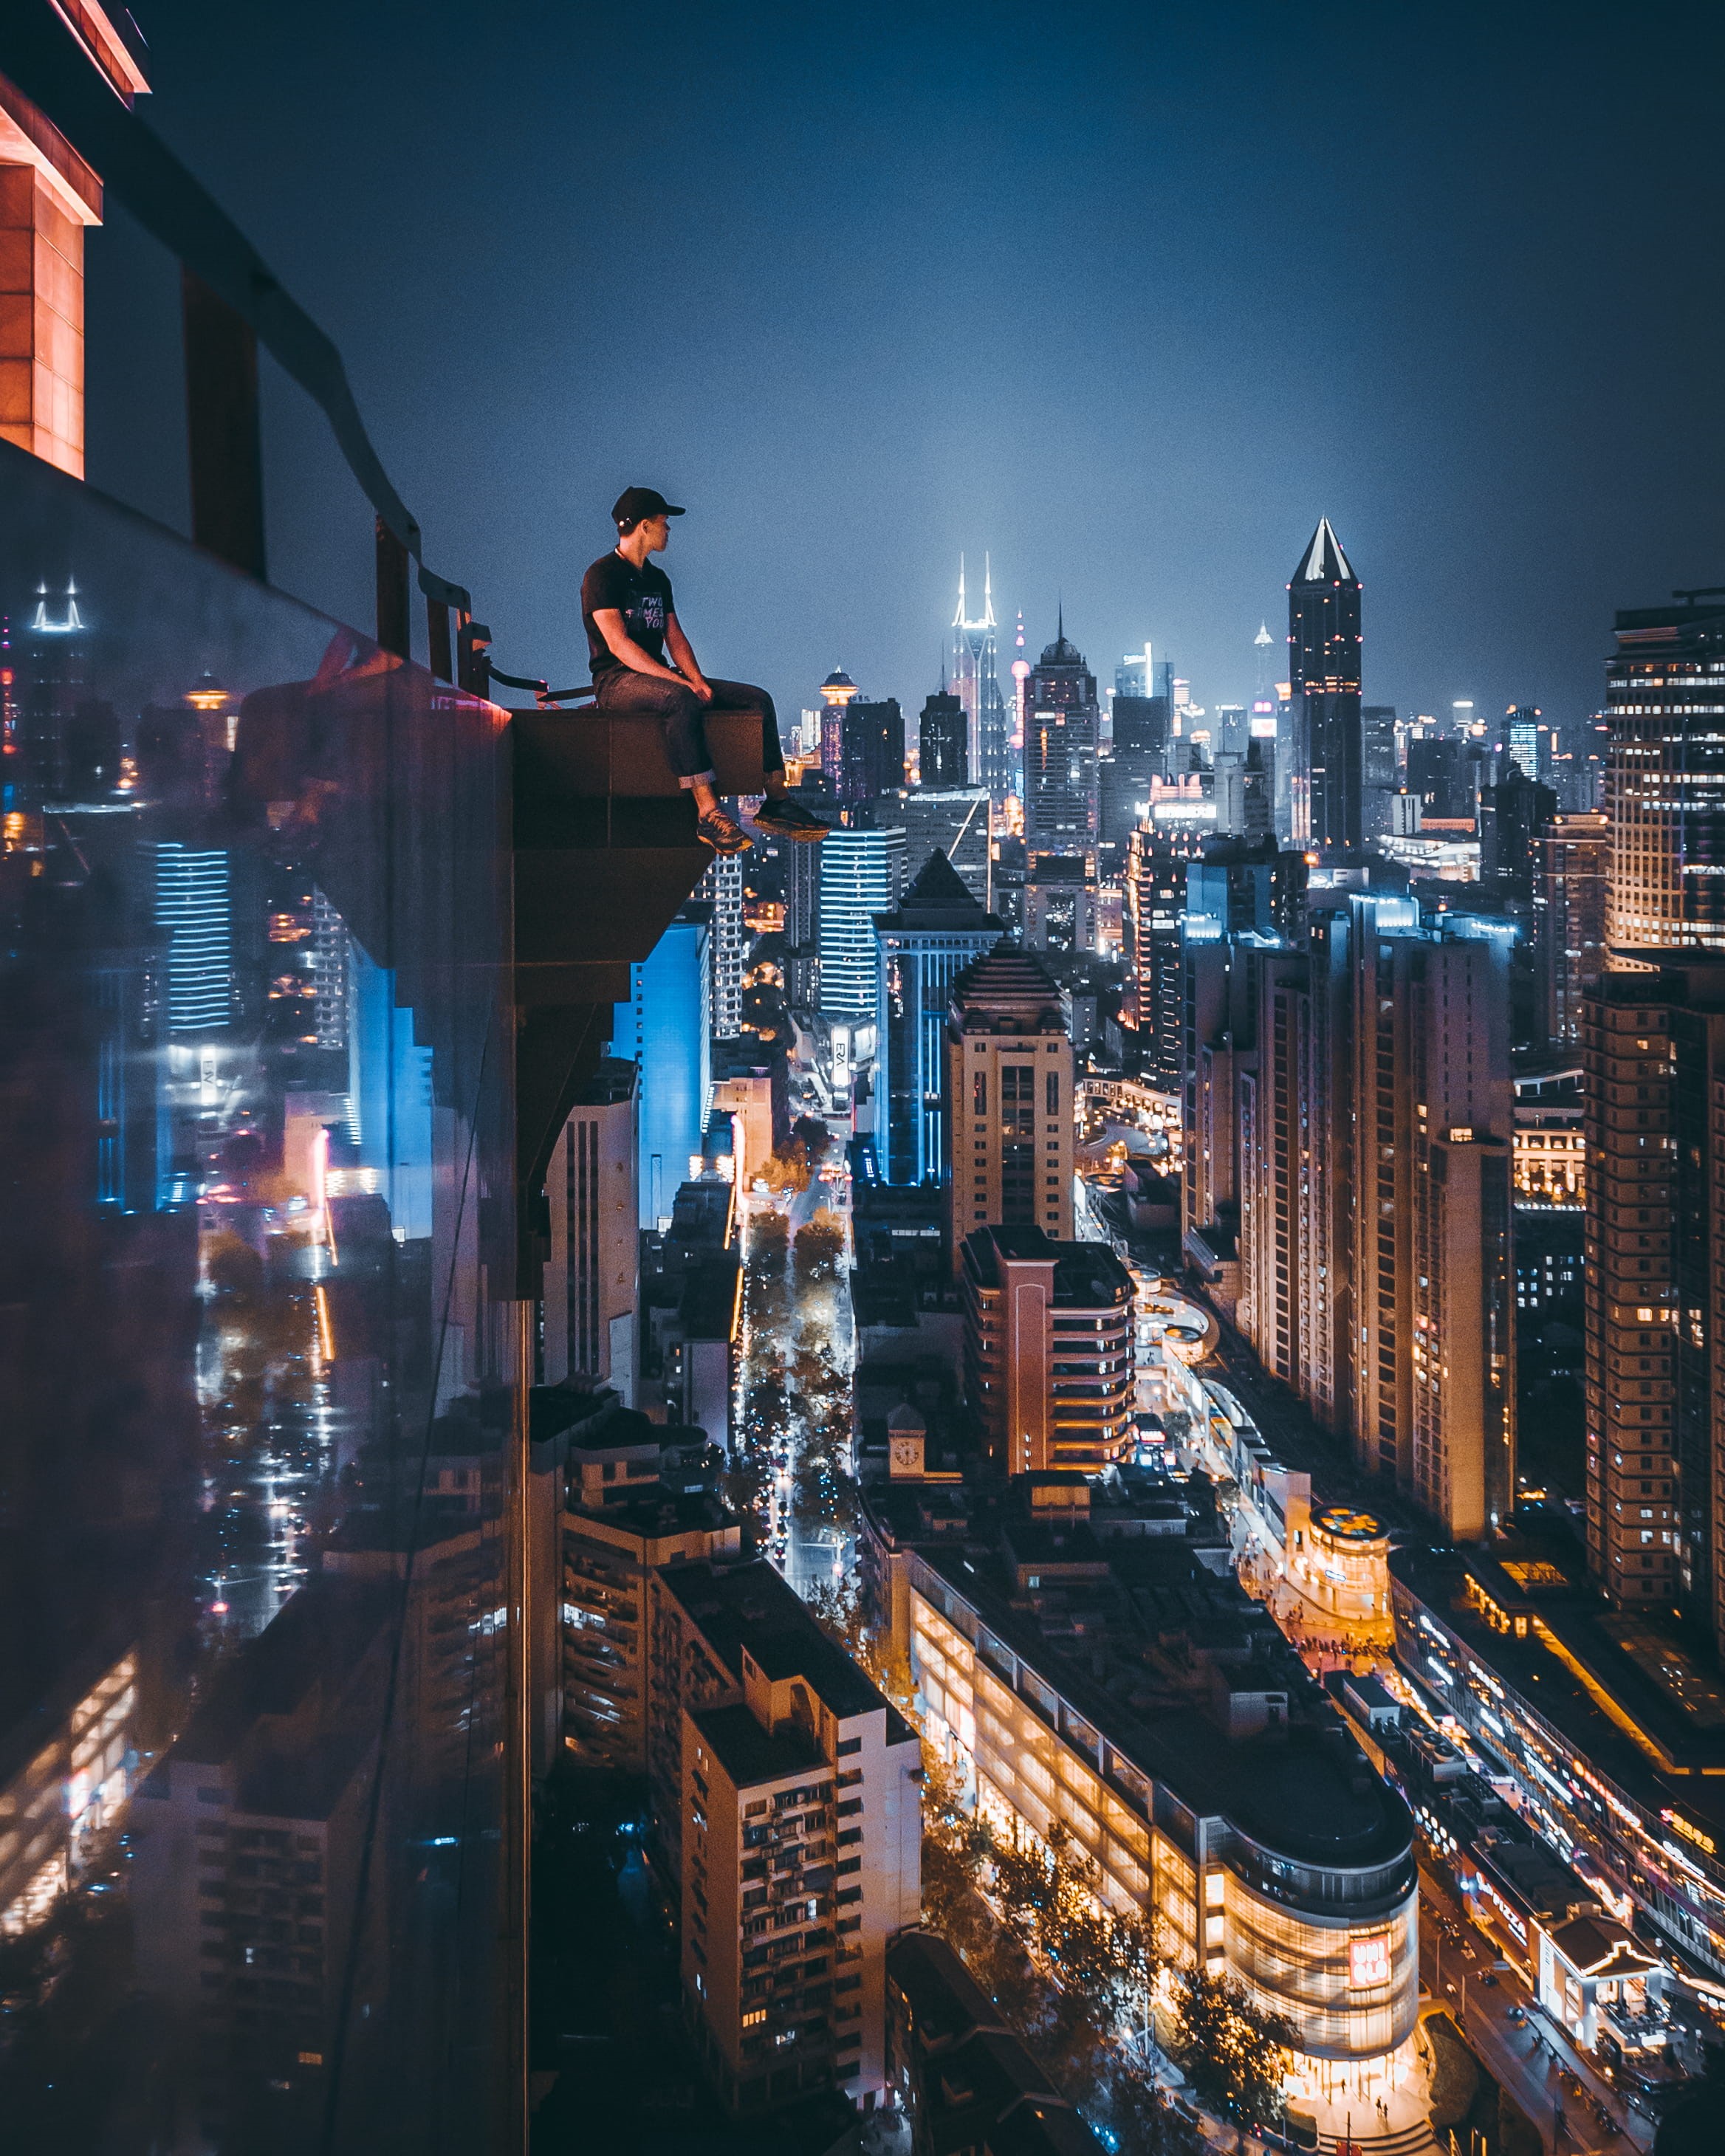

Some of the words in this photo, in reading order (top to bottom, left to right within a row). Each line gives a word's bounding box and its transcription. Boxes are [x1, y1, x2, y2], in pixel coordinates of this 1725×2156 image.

[641, 597, 662, 607] TWO
[1493, 1892, 1527, 1938] PIZZA
[1353, 1941, 1385, 1963] UNI
